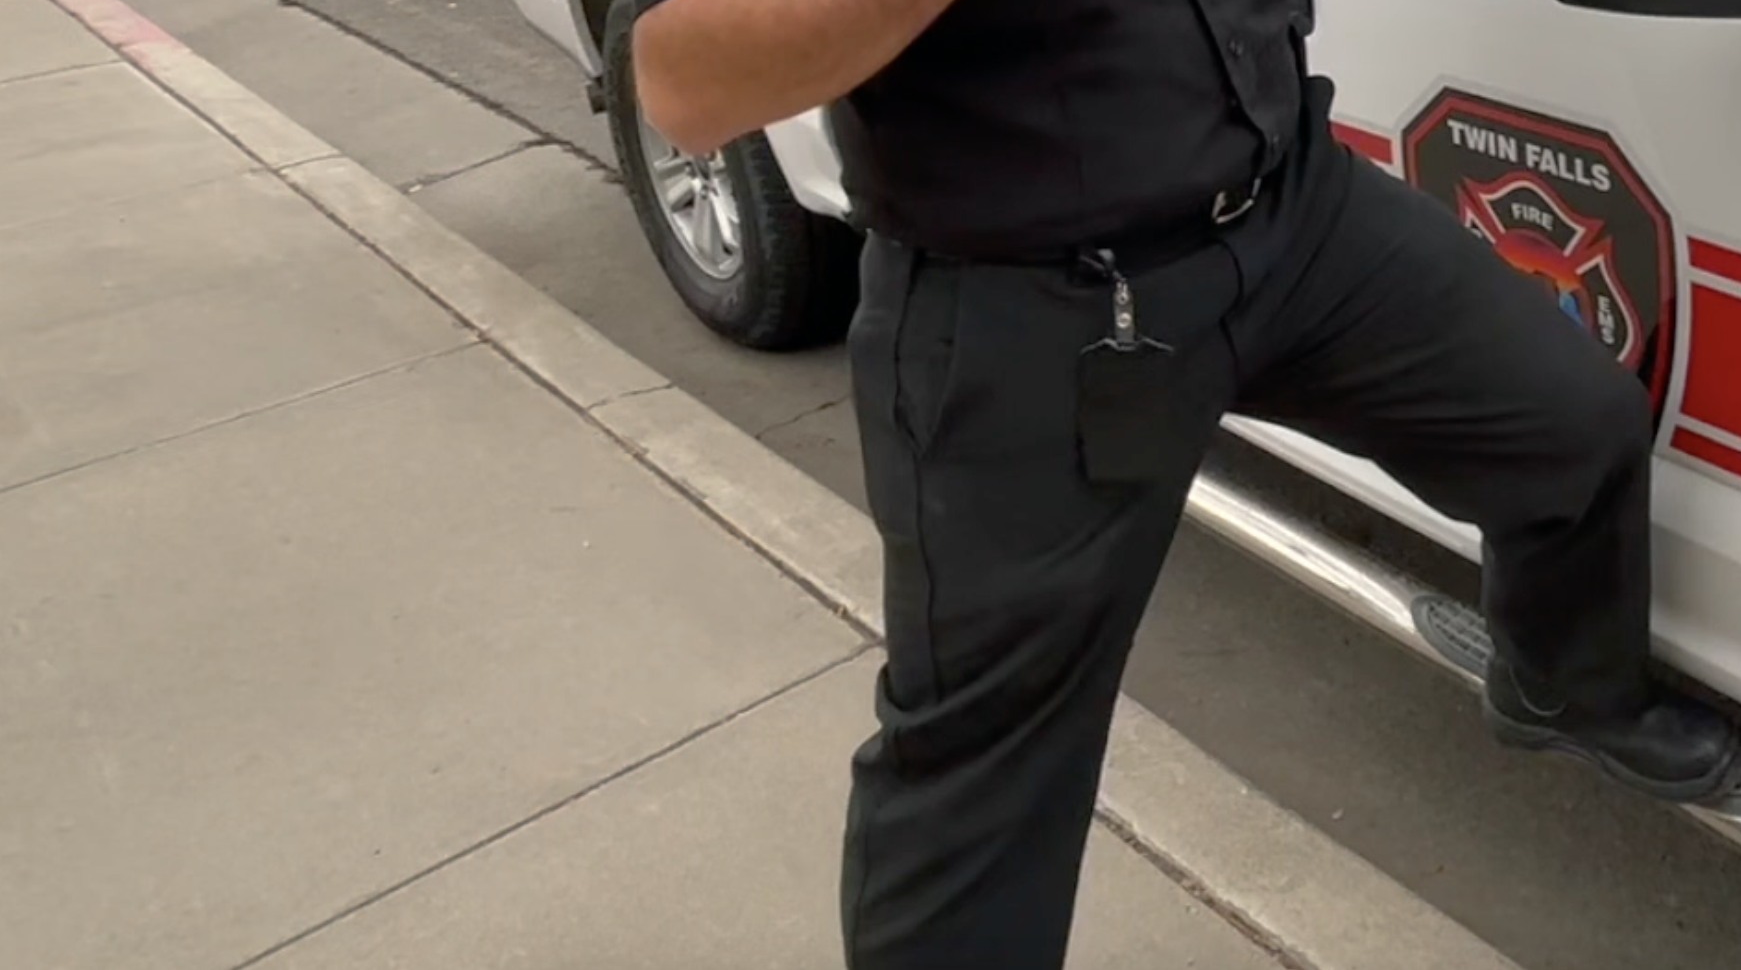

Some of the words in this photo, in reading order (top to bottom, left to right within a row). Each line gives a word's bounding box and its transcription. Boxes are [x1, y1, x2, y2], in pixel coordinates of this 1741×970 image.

[1446, 118, 1518, 163] TWIN
[1525, 142, 1612, 192] FALLS
[1511, 202, 1554, 231] FIRE
[1597, 294, 1616, 345] EMS
